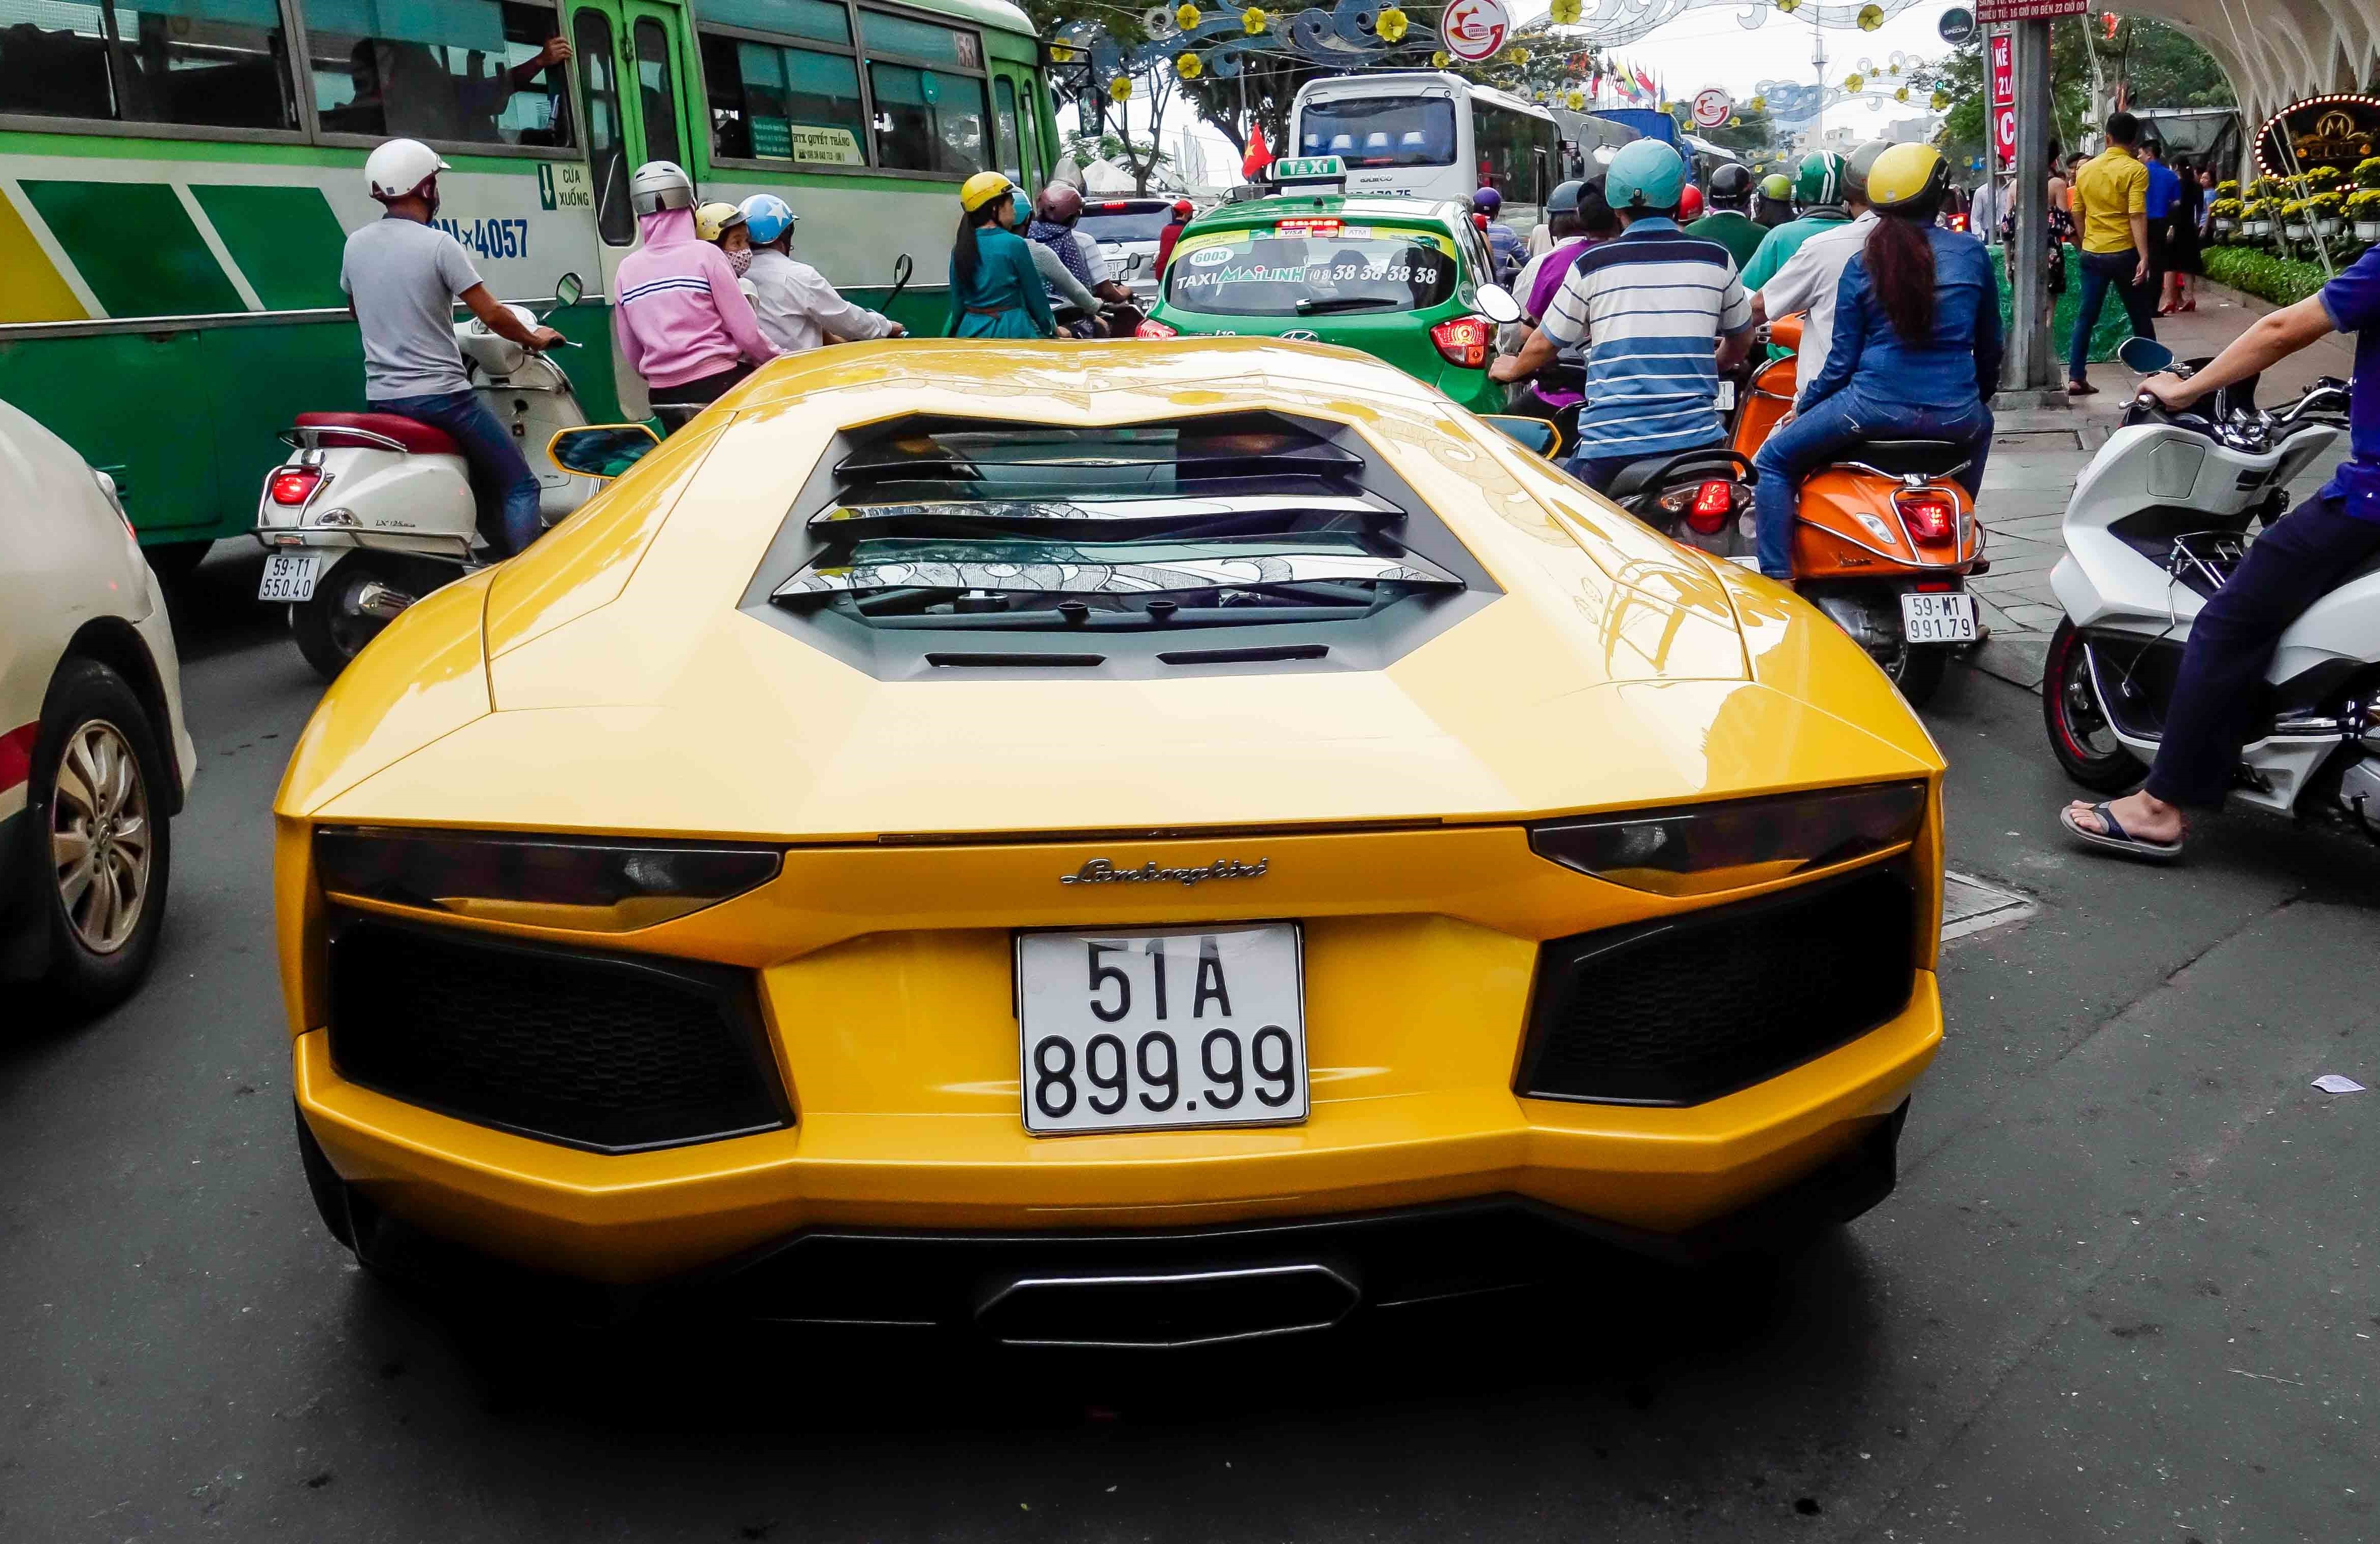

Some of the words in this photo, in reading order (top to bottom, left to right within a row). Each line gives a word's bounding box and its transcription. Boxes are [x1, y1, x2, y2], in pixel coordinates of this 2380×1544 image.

[1195, 251, 1227, 262] 6003
[1333, 264, 1356, 280] 38
[1360, 264, 1383, 280] 38
[1387, 265, 1411, 282] 38
[1415, 267, 1437, 284] 38
[263, 579, 311, 598] 550.40
[1913, 597, 1960, 616] 59-M1
[1910, 618, 1970, 638] 991.79
[1060, 858, 1270, 886] Lamborghini
[1088, 935, 1232, 1023] 51A
[1033, 1025, 1295, 1119] 899.99
